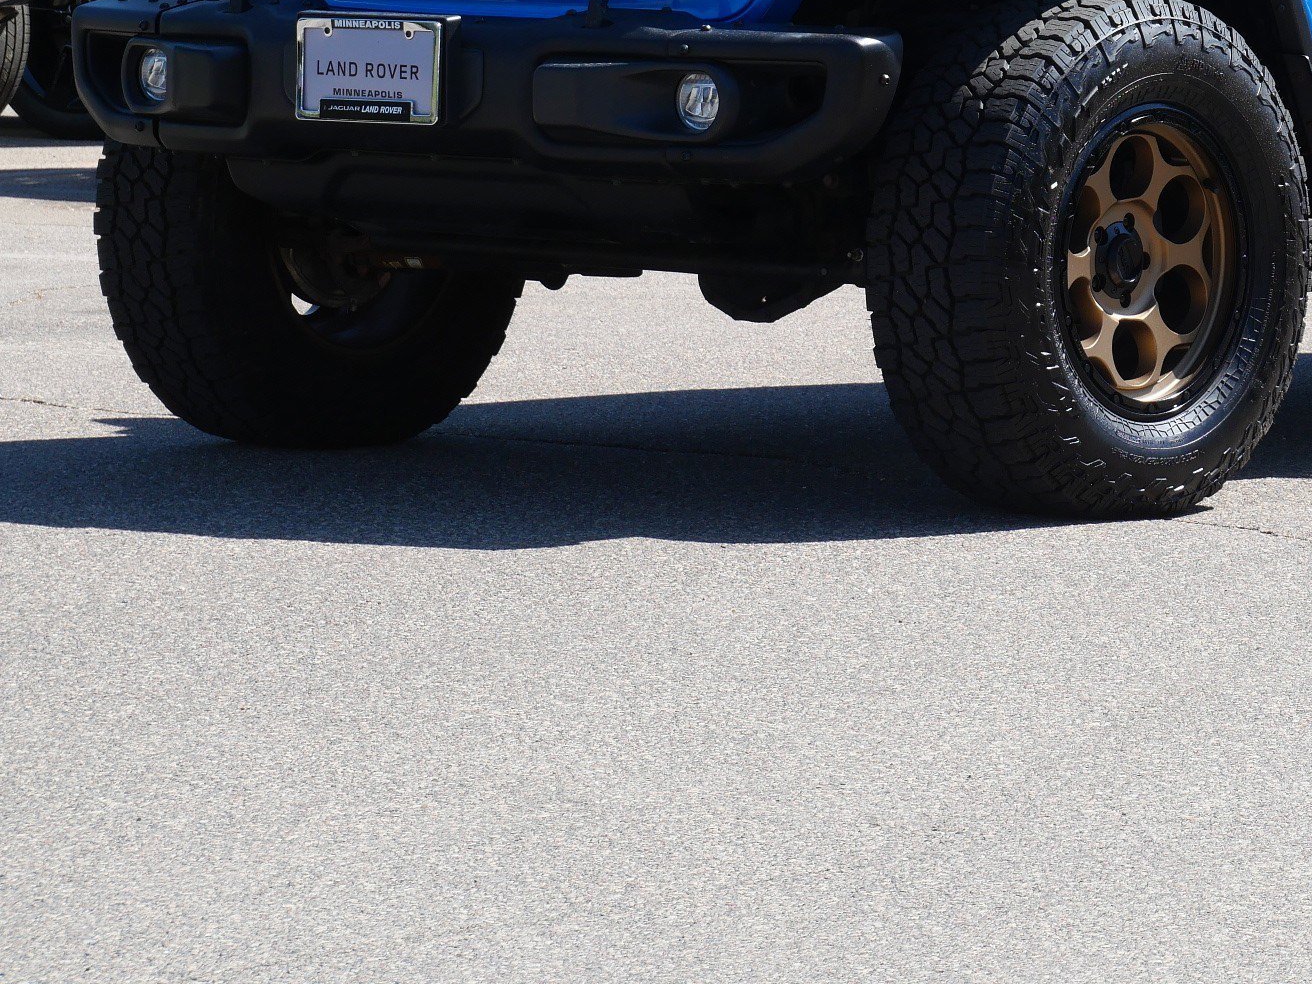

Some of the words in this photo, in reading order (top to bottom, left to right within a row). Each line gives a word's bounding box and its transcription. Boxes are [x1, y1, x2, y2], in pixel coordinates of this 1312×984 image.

[334, 19, 401, 30] MINNEAPOLIS
[317, 60, 358, 76] LAND
[365, 63, 419, 80] ROVER
[333, 88, 403, 99] MINNEAPOLIS
[328, 104, 360, 112] JAGUAR
[361, 105, 379, 114] LAND
[379, 106, 403, 115] ROVER
